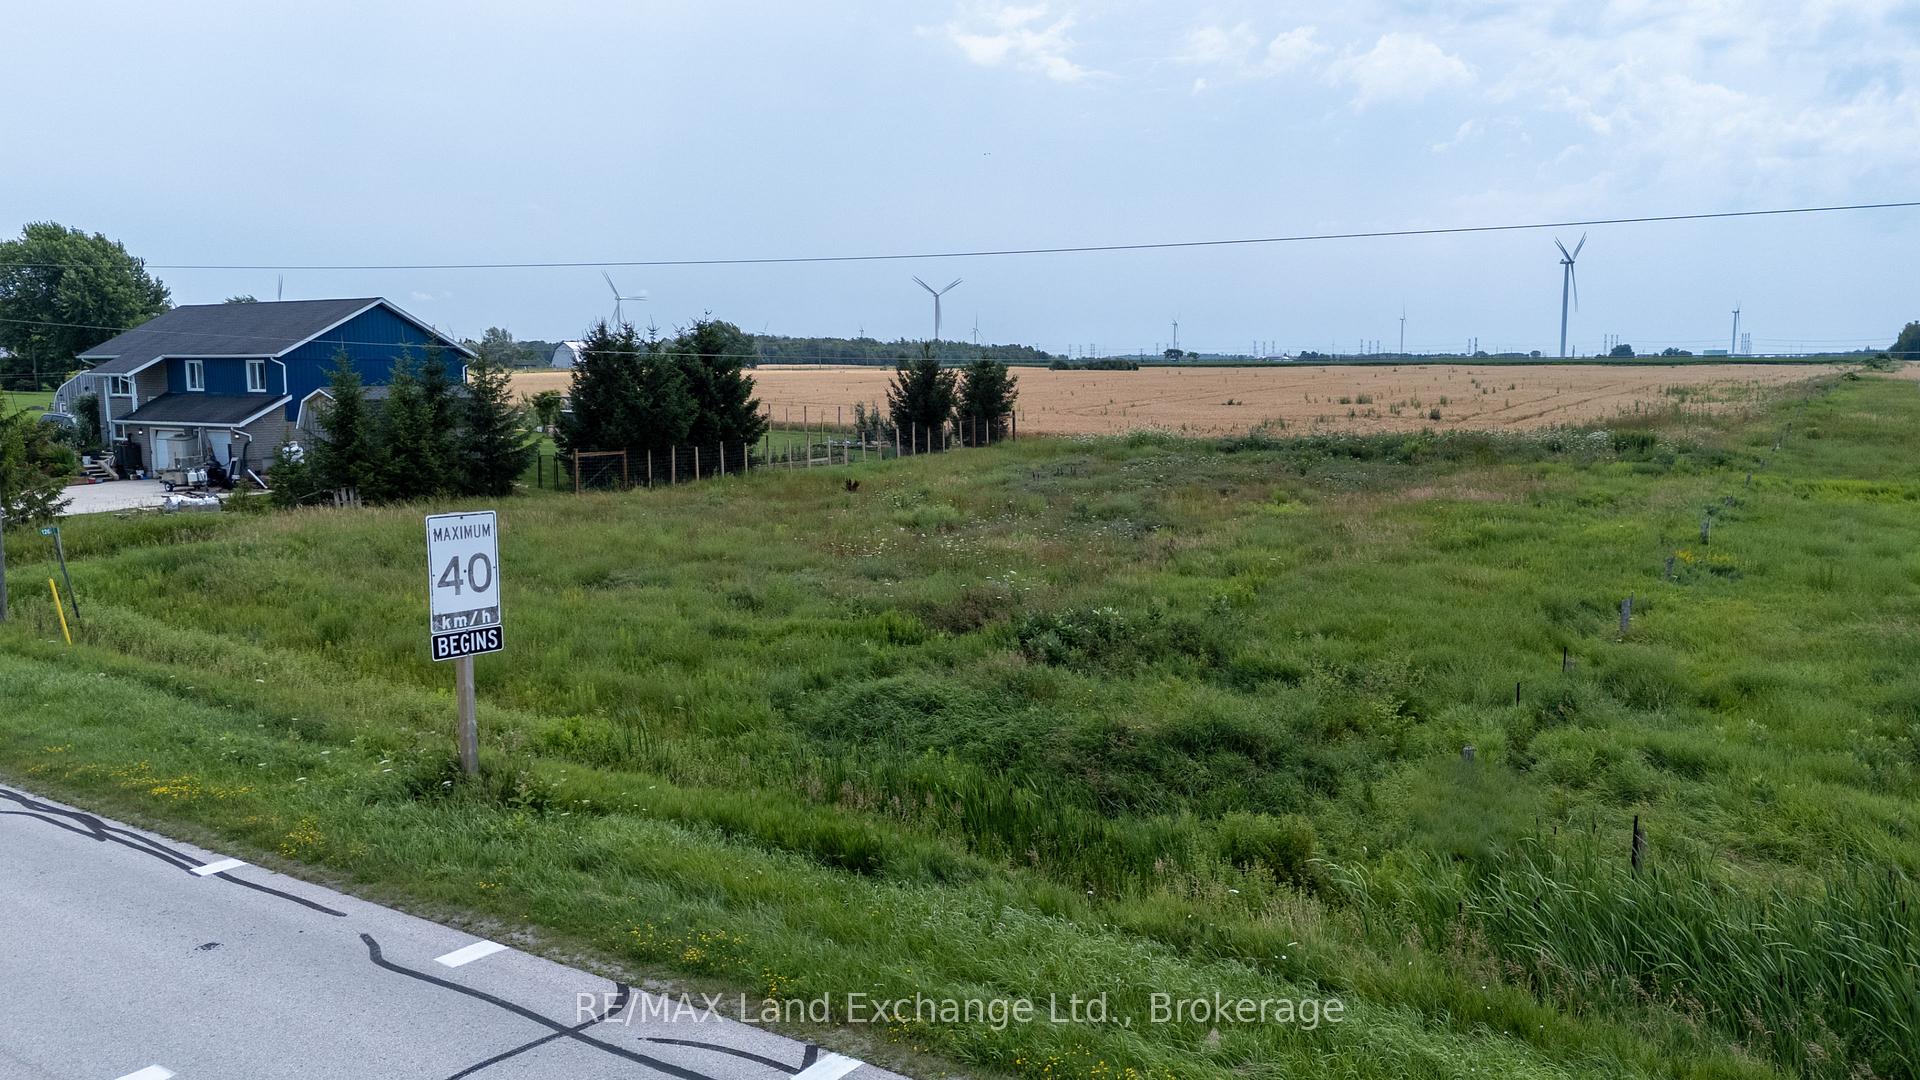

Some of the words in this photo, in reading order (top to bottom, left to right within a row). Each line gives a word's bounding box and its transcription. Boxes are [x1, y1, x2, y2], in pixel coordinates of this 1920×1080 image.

[433, 523, 491, 543] MAXIMUM
[437, 552, 492, 596] 40
[442, 610, 491, 630] km/h
[437, 629, 498, 657] BEGINS
